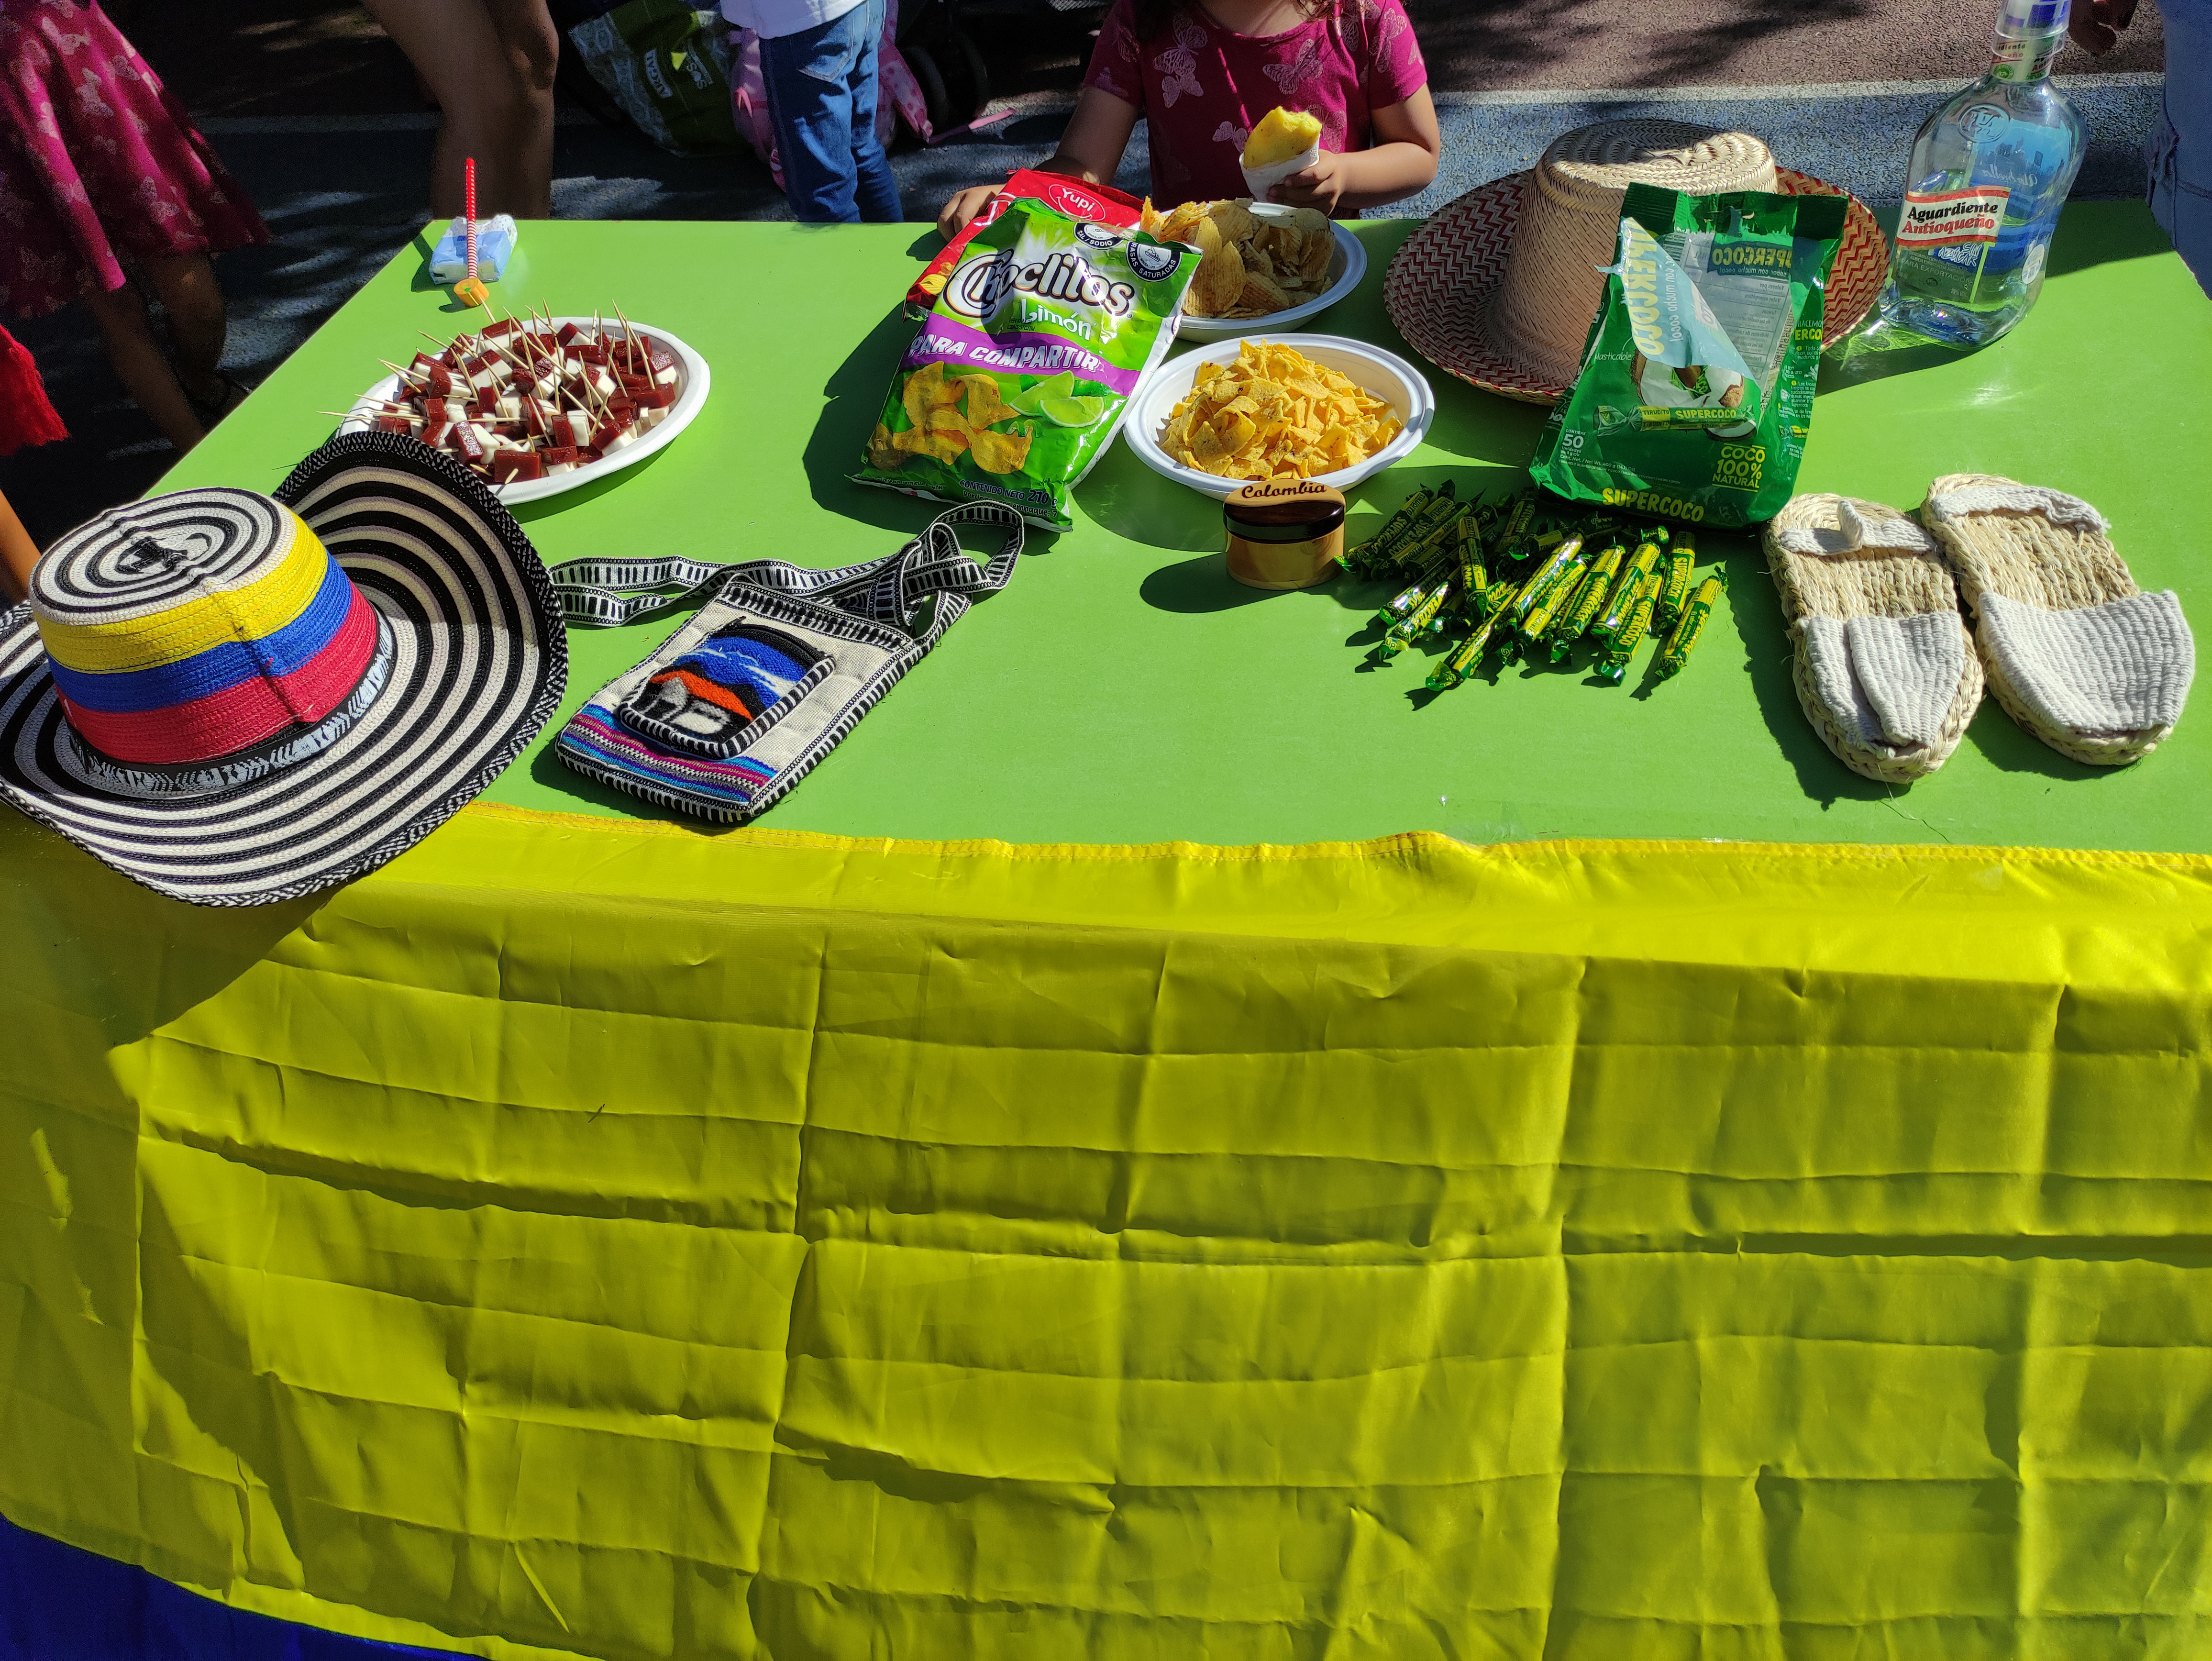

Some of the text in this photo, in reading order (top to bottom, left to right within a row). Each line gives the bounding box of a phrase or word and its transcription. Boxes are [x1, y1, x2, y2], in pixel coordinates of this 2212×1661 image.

[1062, 188, 1095, 212] Yupi
[1907, 202, 1998, 223] Aguardiente
[1902, 214, 1995, 234] Antioqueño
[1077, 230, 1086, 240] SAL
[1938, 246, 1977, 267] AZÚCAR
[1962, 242, 1982, 256] SIN
[1139, 259, 1176, 278] SATURADAS
[1021, 298, 1092, 340] Limón
[908, 334, 1101, 373] PARA COMPARTIR
[1675, 409, 1736, 419] SUPERCOCO
[1562, 434, 1584, 448] 50
[1721, 446, 1765, 463] COCO
[1717, 459, 1762, 480] 100%
[1241, 481, 1327, 499] Colombia
[1712, 473, 1759, 488] NATURAL
[960, 479, 1003, 495] CONTENIDO
[1005, 489, 1025, 500] NETO
[1028, 489, 1050, 504] 210
[1013, 504, 1051, 517] empaque:
[1407, 492, 1426, 516] TIRUDITO
[1602, 487, 1704, 522] SUPERCOCO
[1619, 600, 1652, 647] SUPERCOCO
